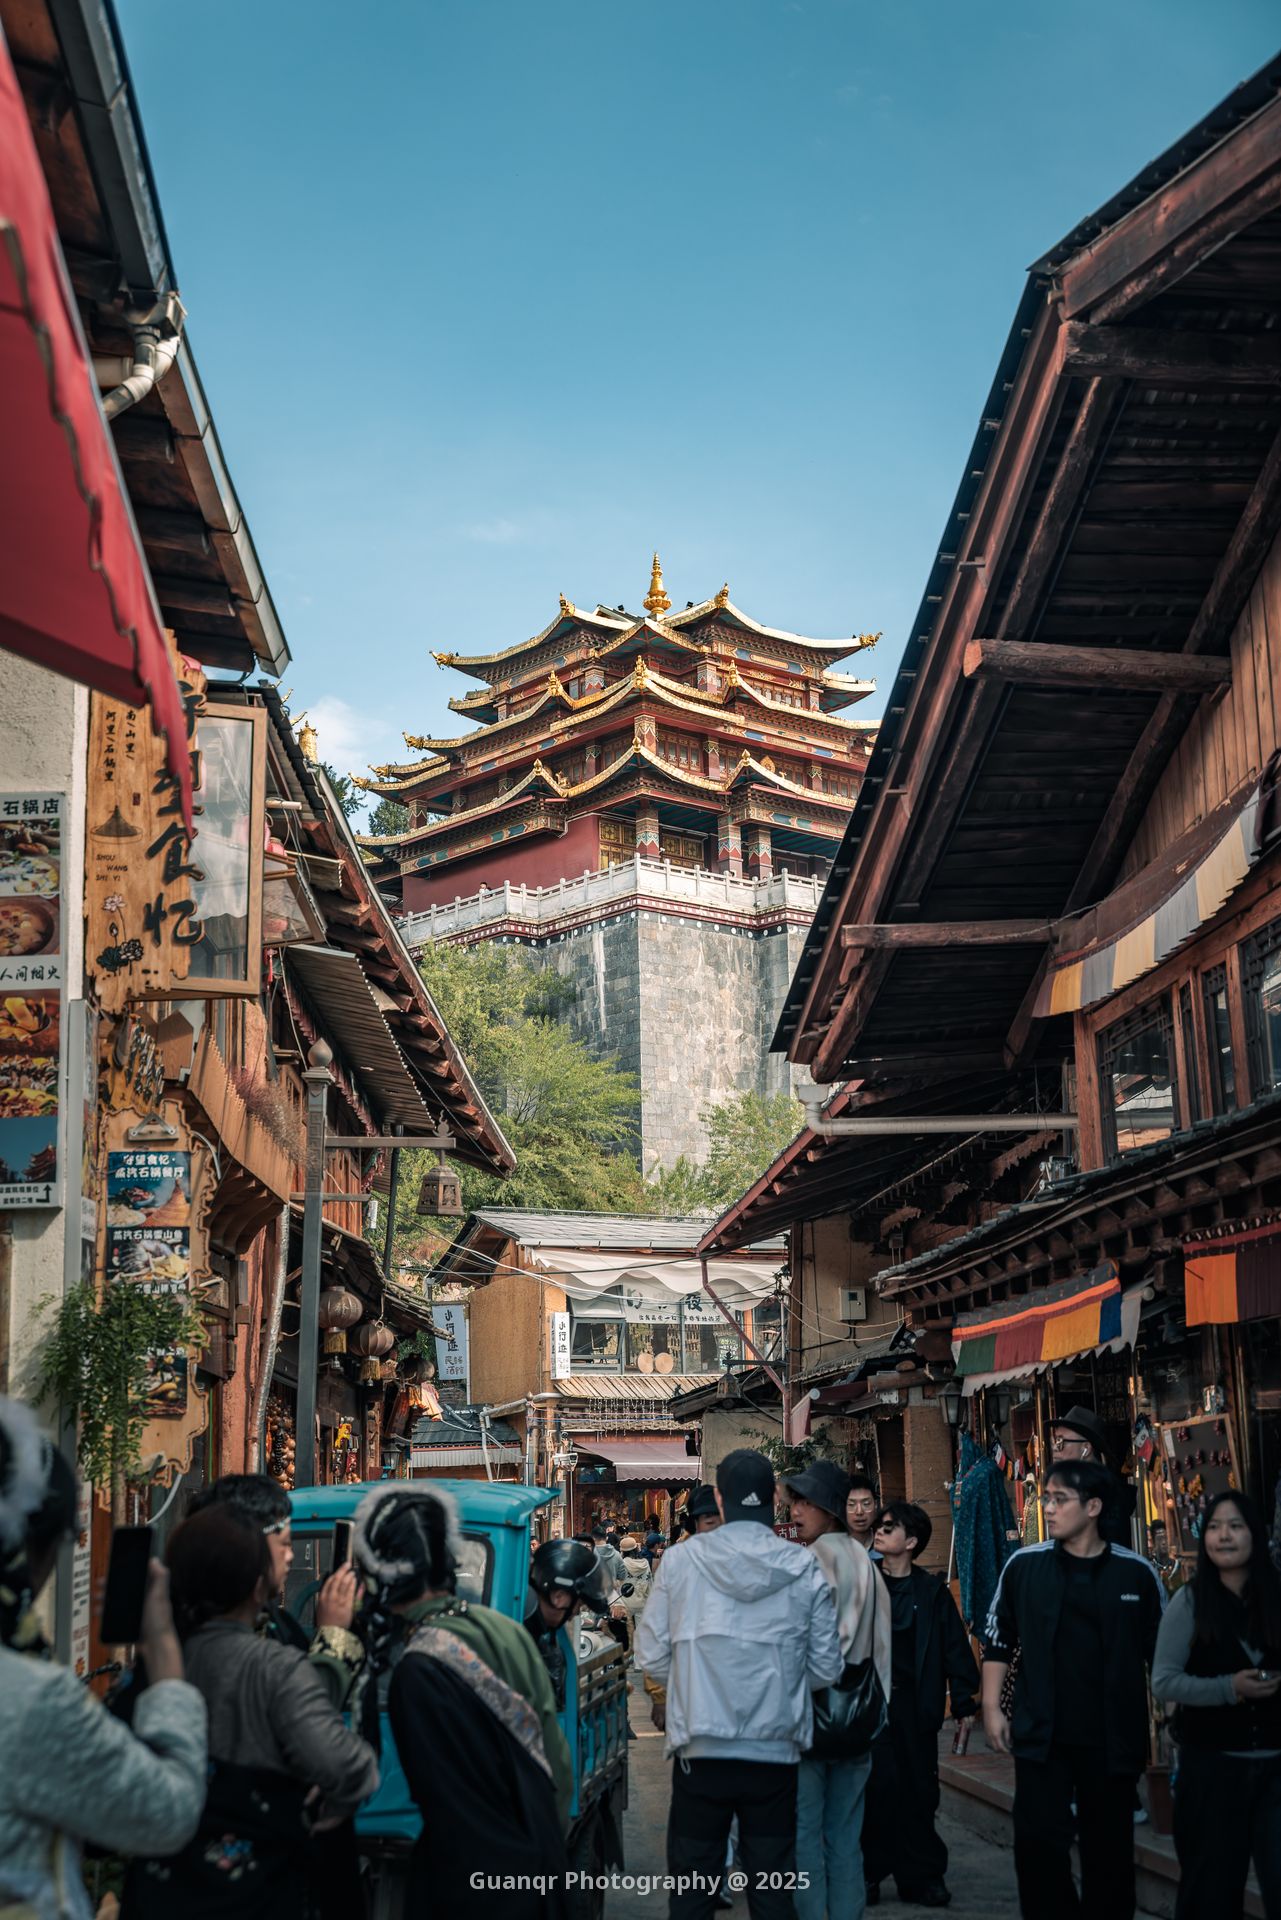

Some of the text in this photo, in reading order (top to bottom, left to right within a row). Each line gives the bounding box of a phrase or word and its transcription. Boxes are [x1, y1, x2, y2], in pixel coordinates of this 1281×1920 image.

[3, 798, 60, 815] 石锅店
[96, 854, 115, 862] SHOU
[106, 864, 128, 872] WANG
[0, 965, 60, 982] 人间烟火
[115, 1166, 185, 1179] 蒸汽石锅餐厅
[558, 1321, 568, 1353] 小行迹
